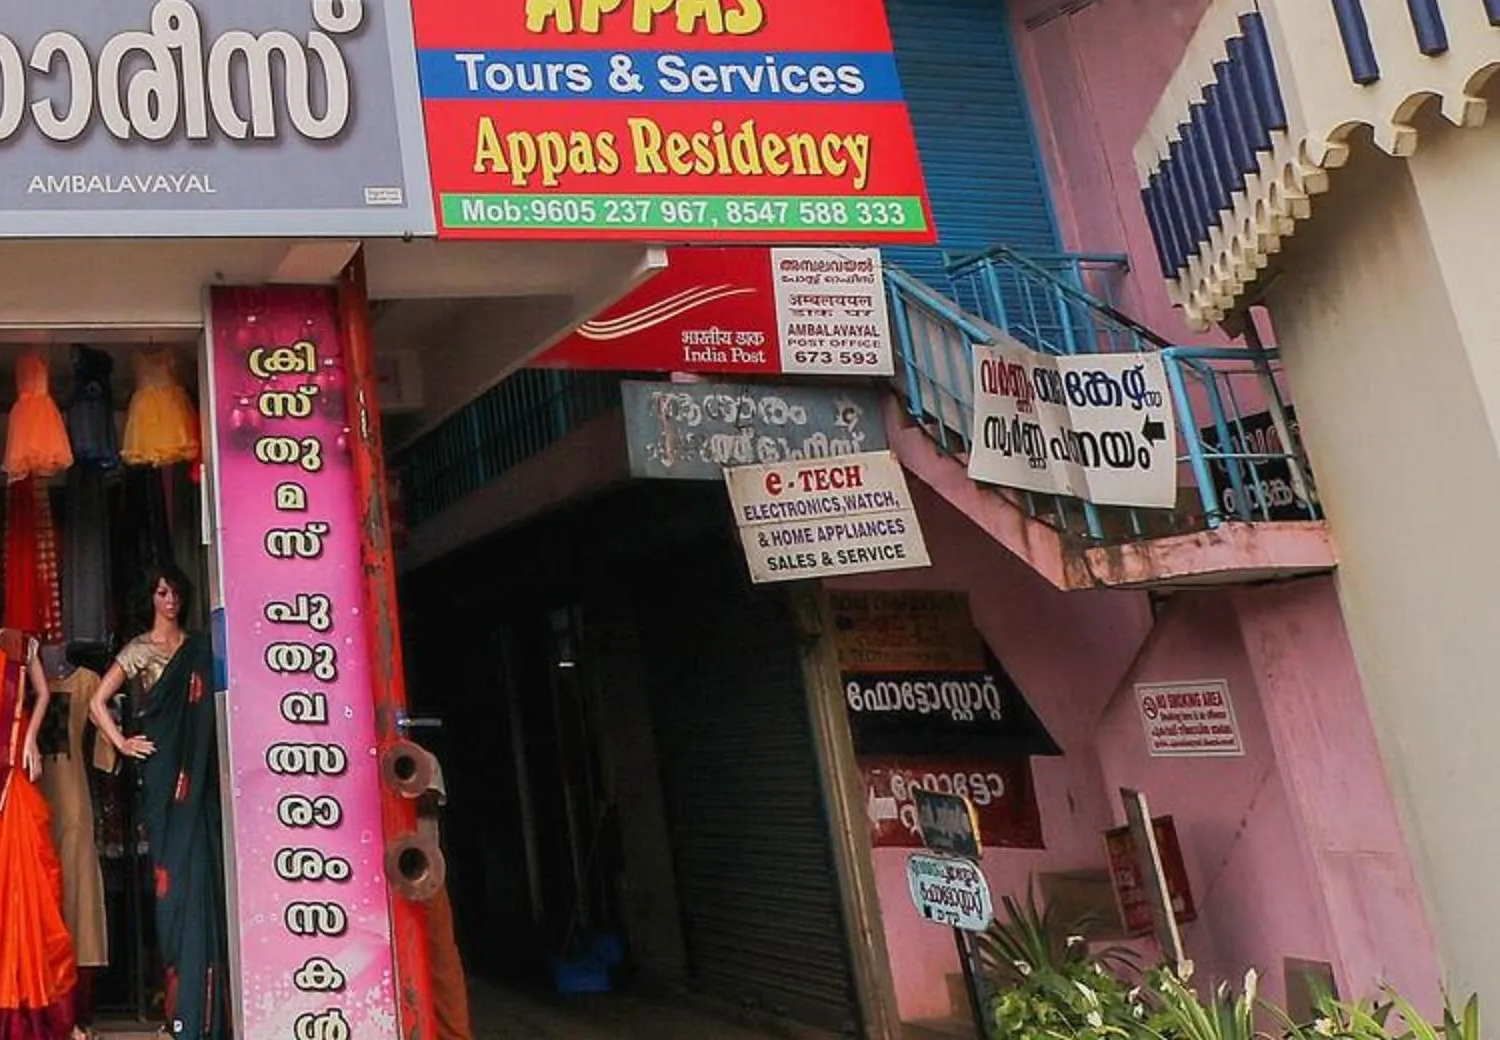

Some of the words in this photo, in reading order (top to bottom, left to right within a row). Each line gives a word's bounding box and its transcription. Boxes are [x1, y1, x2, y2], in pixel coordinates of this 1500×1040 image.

[455, 52, 593, 94] Tours
[608, 54, 644, 94] &
[657, 53, 866, 95] Services
[473, 116, 620, 188] Appas
[627, 117, 871, 190] Residency
[28, 173, 217, 194] AMBALAVAYAL
[462, 199, 596, 224] Mob:9605
[605, 201, 650, 224] 237
[727, 201, 789, 224] 8547
[799, 202, 847, 225] 588
[857, 202, 906, 225] 333
[787, 323, 881, 338] AMBALAVAYAL
[683, 345, 727, 362] India
[730, 347, 767, 364] Post
[787, 339, 826, 348] POST
[829, 339, 881, 349] OFFICE
[794, 351, 833, 364] 673
[839, 351, 879, 365] 593
[757, 531, 769, 548] &
[771, 526, 814, 547] HOME
[817, 518, 906, 542] APPLIANCES
[767, 553, 817, 571] SALES
[821, 551, 833, 566] &
[836, 543, 906, 565] SERVICE
